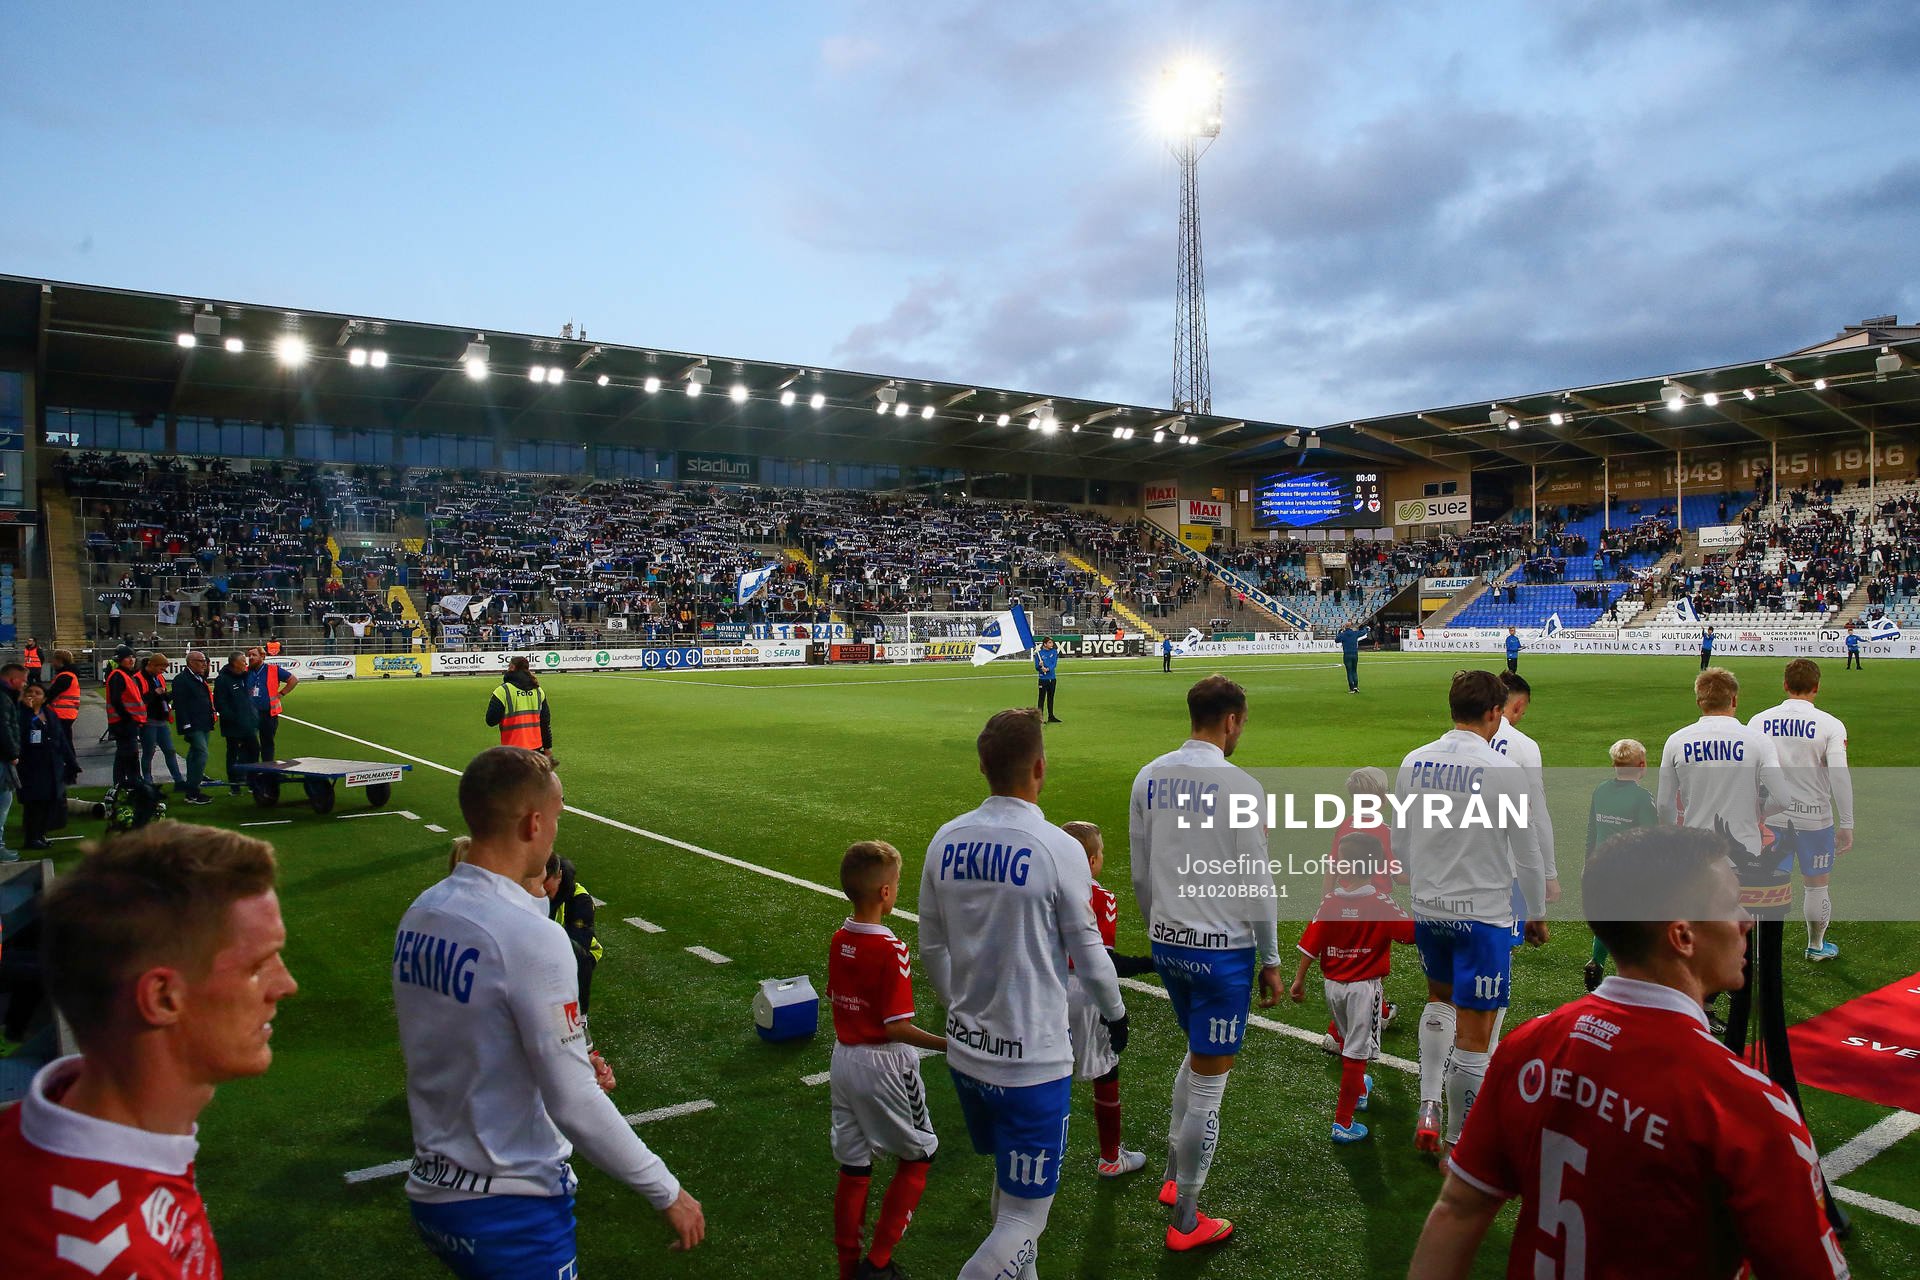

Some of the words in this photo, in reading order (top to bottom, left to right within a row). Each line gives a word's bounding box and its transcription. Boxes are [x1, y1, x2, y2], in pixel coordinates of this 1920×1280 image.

[687, 457, 750, 474] stadium
[1738, 453, 1809, 478] 1945
[1831, 445, 1905, 471] 1946
[1356, 474, 1377, 482] 00:00
[1663, 461, 1723, 485] 1943
[1146, 487, 1176, 501] MAXI
[1356, 485, 1361, 493] 0
[1371, 485, 1376, 493] 0
[1190, 501, 1222, 516] MAXI
[1428, 501, 1467, 516] suez
[1434, 579, 1473, 588] REJLERS
[1207, 561, 1309, 631] NORDAHL
[1269, 633, 1299, 641] RETEK
[1558, 630, 1575, 639] HISS
[1661, 632, 1732, 640] KULTURMARNA
[774, 649, 800, 657] SEFAB
[887, 646, 900, 657] DS
[925, 642, 975, 656] BLÅKLÄD
[1055, 640, 1125, 654] XL-BYGG
[1251, 643, 1290, 651] COLLECTION
[1297, 641, 1343, 650] PLATINUMC
[1409, 641, 1480, 649] PLATINUMCARS
[1573, 642, 1661, 651] PLATINUMCARS
[1675, 643, 1774, 652] PLATNUMCARS
[1819, 645, 1891, 653] COLLTION
[440, 654, 485, 665] Scandic
[497, 653, 540, 663] Scdic
[1763, 718, 1816, 739] PEKING
[1683, 740, 1744, 763] PEKING
[356, 771, 393, 780] THOLMARKS
[1411, 760, 1485, 793] PEKING
[1147, 778, 1220, 817] PEKING
[1790, 801, 1822, 815] dium
[939, 841, 1032, 887] PEKING
[1812, 851, 1831, 869] nt
[1152, 922, 1229, 948] stadium
[1474, 971, 1504, 1000] nt
[1208, 1013, 1241, 1045] nt
[945, 1015, 1023, 1060] stadium
[409, 1154, 493, 1194] adium
[1008, 1148, 1051, 1187] nt
[1532, 1127, 1589, 1280] 5
